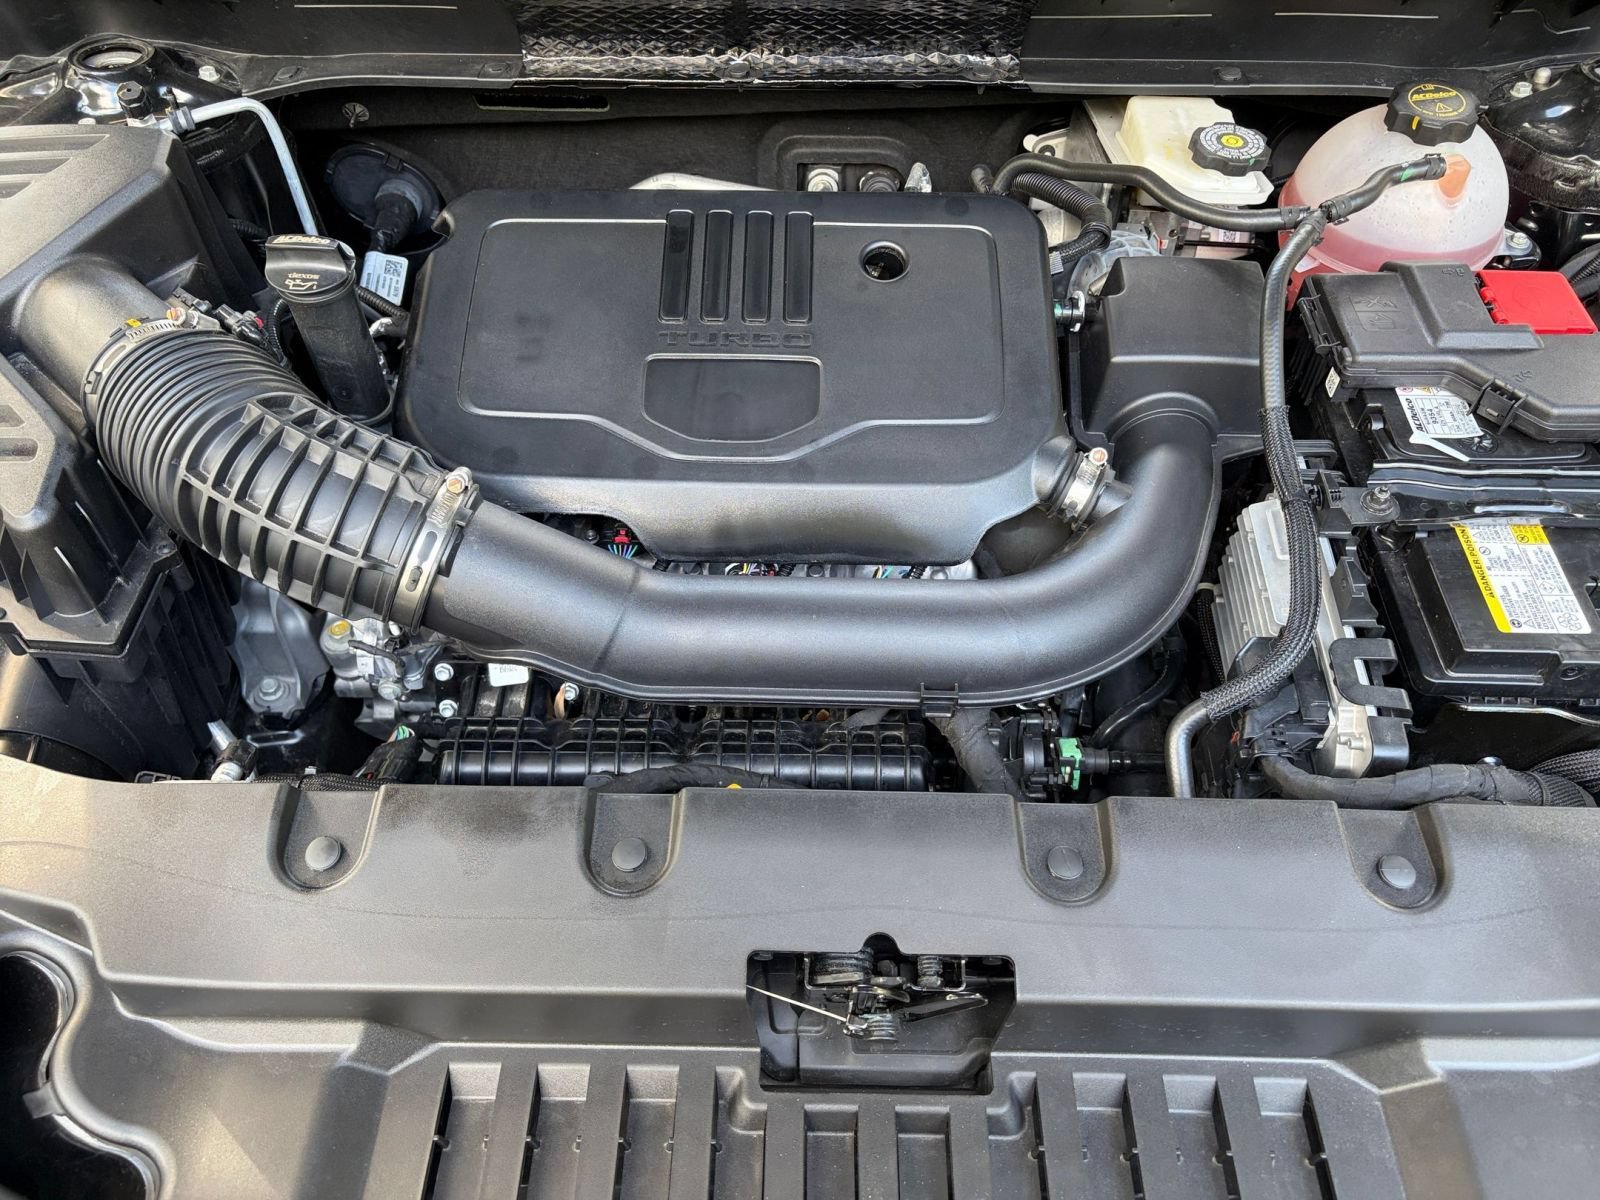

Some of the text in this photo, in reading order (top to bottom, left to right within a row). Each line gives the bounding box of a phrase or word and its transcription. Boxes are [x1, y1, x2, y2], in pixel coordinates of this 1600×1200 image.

[1412, 91, 1457, 102] ACDelco
[272, 235, 330, 245] ACDelco
[288, 272, 321, 280] dexos
[658, 331, 812, 348] TURBO
[1405, 398, 1425, 433] ACDelco
[1460, 527, 1478, 557] POISON
[1473, 559, 1492, 592] DANGER
